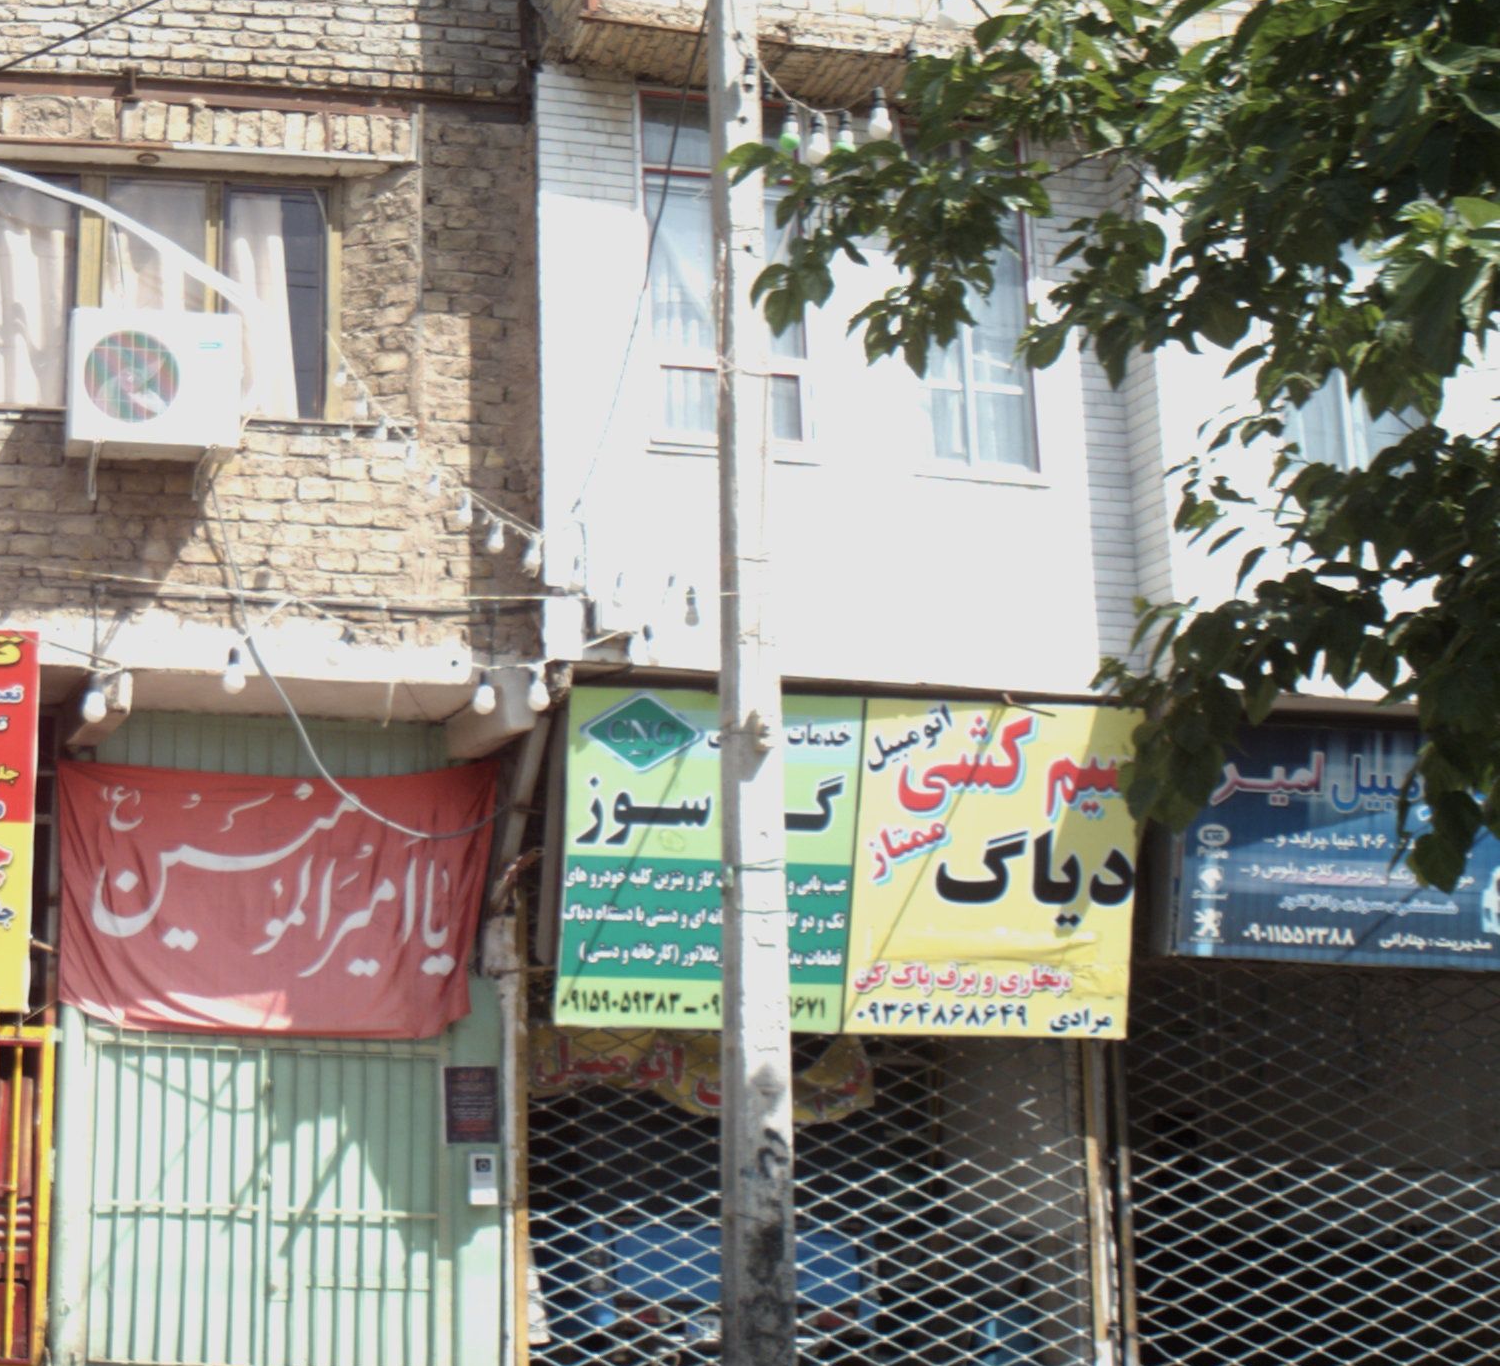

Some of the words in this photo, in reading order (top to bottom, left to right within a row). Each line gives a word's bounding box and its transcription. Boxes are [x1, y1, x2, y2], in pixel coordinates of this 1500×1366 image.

[606, 718, 677, 747] CNG
[787, 719, 852, 747] خدمات
[867, 702, 953, 773] اتومبیل
[897, 715, 1036, 816] کشی
[574, 775, 713, 846] سوز
[935, 827, 1136, 928] دیاگ
[983, 975, 994, 994] و
[1049, 1007, 1113, 1034] مرادی
